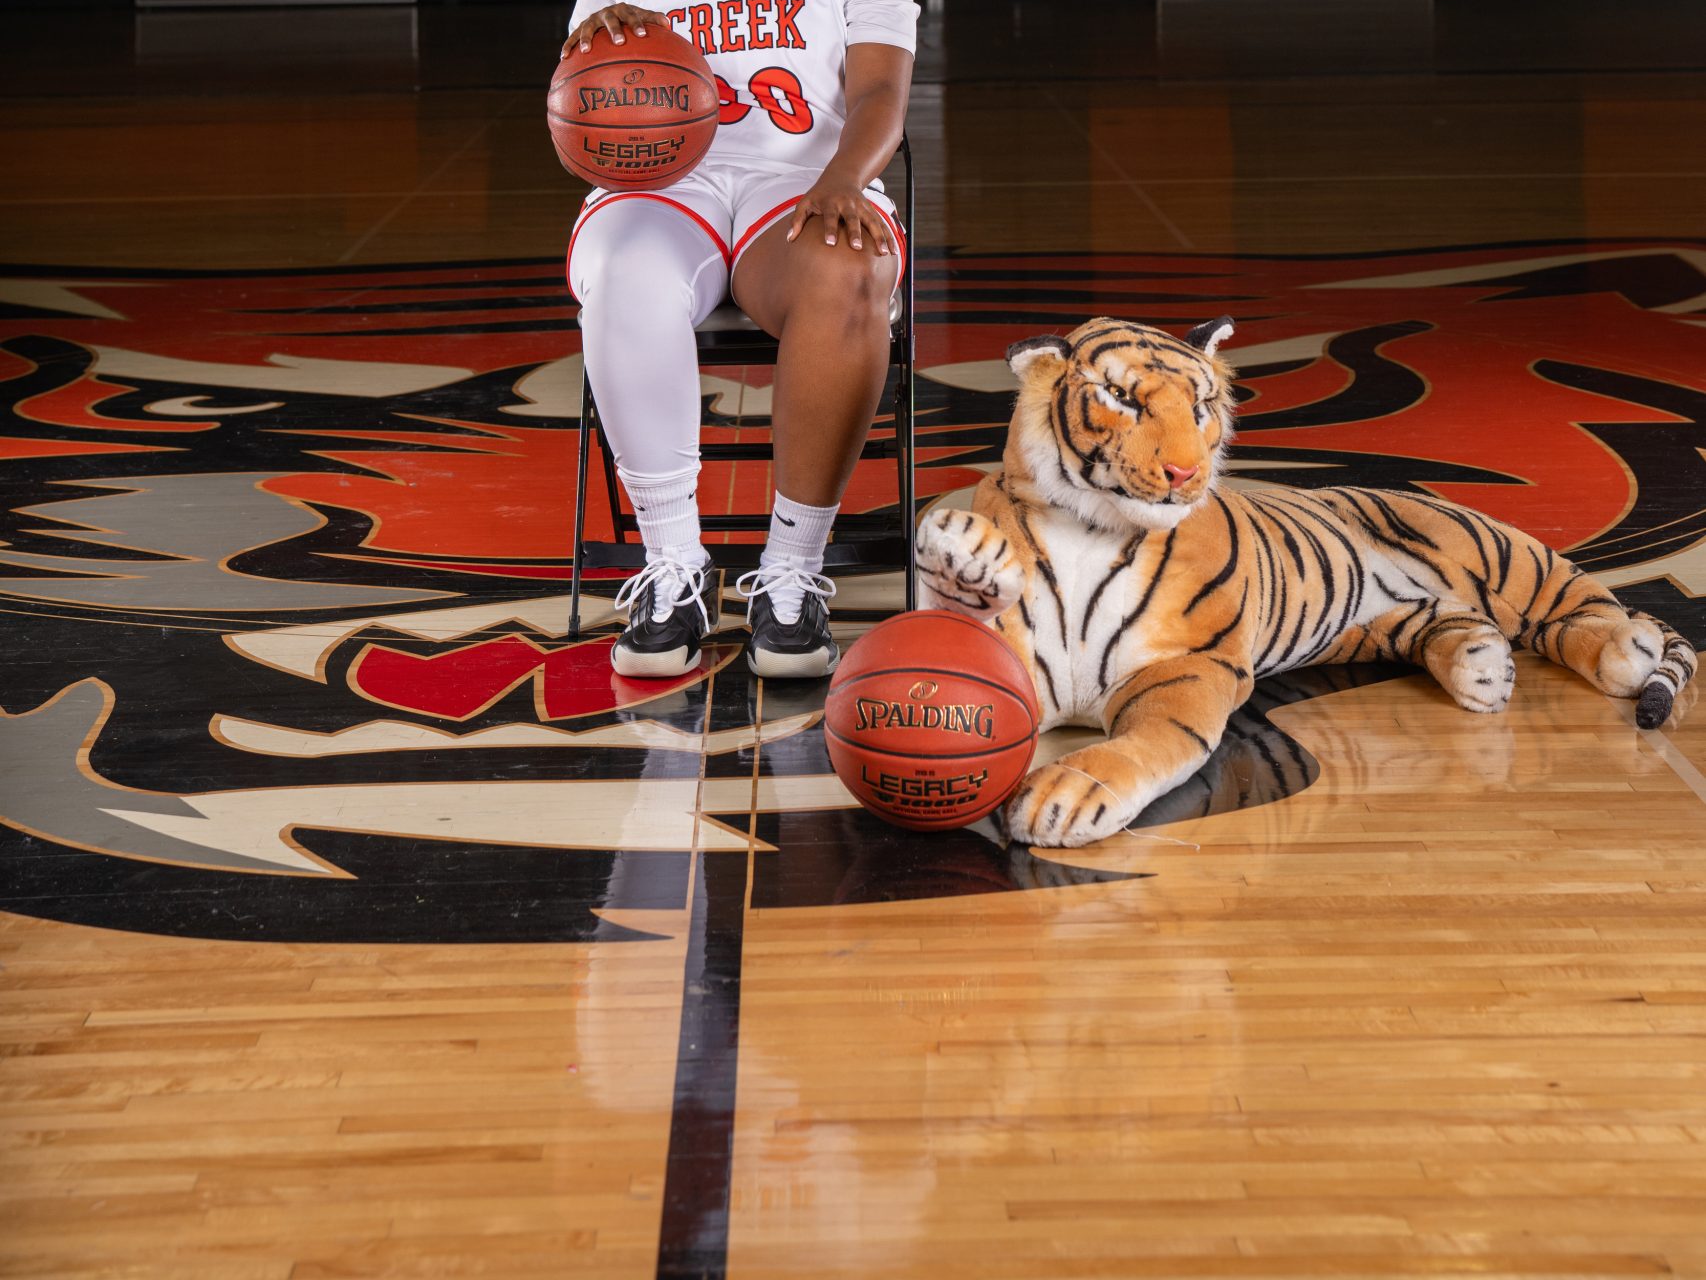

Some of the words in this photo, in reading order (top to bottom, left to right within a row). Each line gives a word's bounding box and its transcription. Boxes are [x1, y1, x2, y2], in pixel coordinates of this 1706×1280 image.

[578, 83, 690, 114] SPALDING
[583, 134, 686, 159] LEGACY
[855, 696, 994, 739] SPALDING
[861, 764, 989, 797] LEGACY
